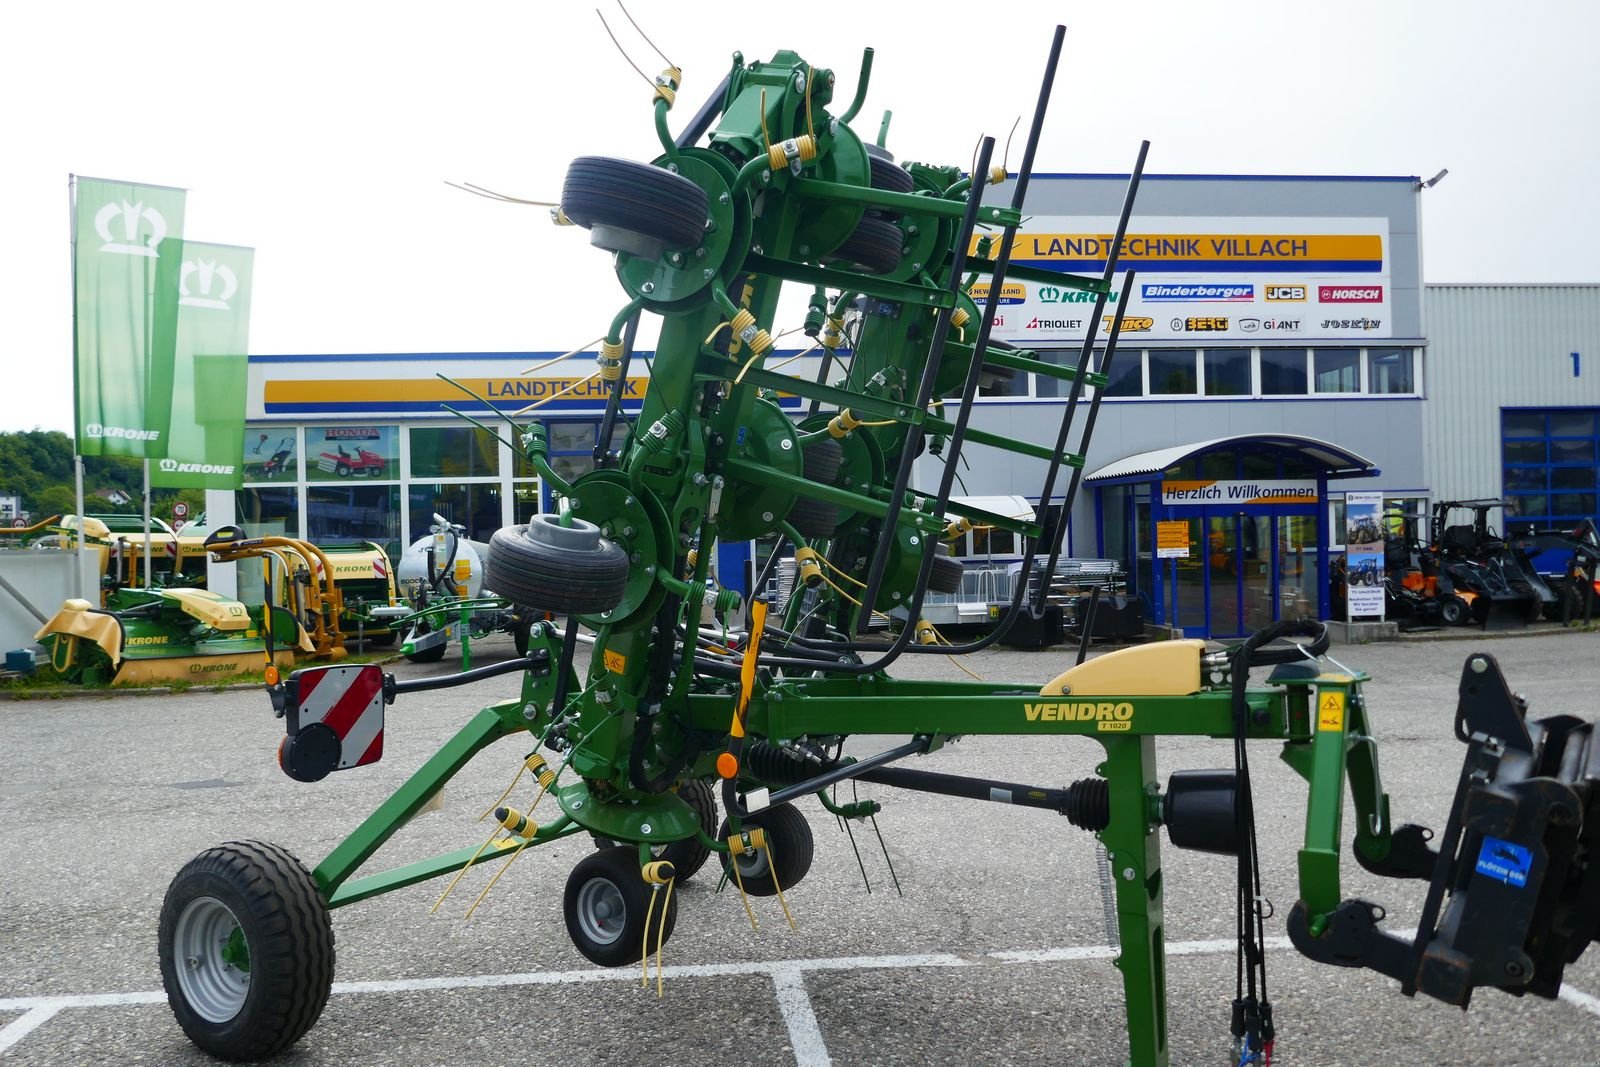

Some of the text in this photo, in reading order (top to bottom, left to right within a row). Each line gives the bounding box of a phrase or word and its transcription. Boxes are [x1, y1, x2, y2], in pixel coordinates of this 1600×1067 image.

[1033, 239, 1307, 256] LANDTECHNIK VILLACH
[1061, 292, 1119, 302] KRON
[1145, 286, 1251, 297] Binderberger
[1267, 288, 1304, 299] JCB
[1332, 290, 1379, 299] HORSCH
[1038, 320, 1082, 328] TRIOLIET
[1321, 318, 1381, 330] JOSKIN
[488, 380, 638, 397] LANDTECHNK
[102, 426, 160, 441] KRONE
[326, 428, 380, 437] HONDA
[177, 464, 235, 475] KRONE
[1166, 485, 1314, 499] Herzlich Willkommen
[128, 636, 169, 645] KRONE
[201, 663, 238, 673] KRONE
[1024, 703, 1134, 721] VENDRO
